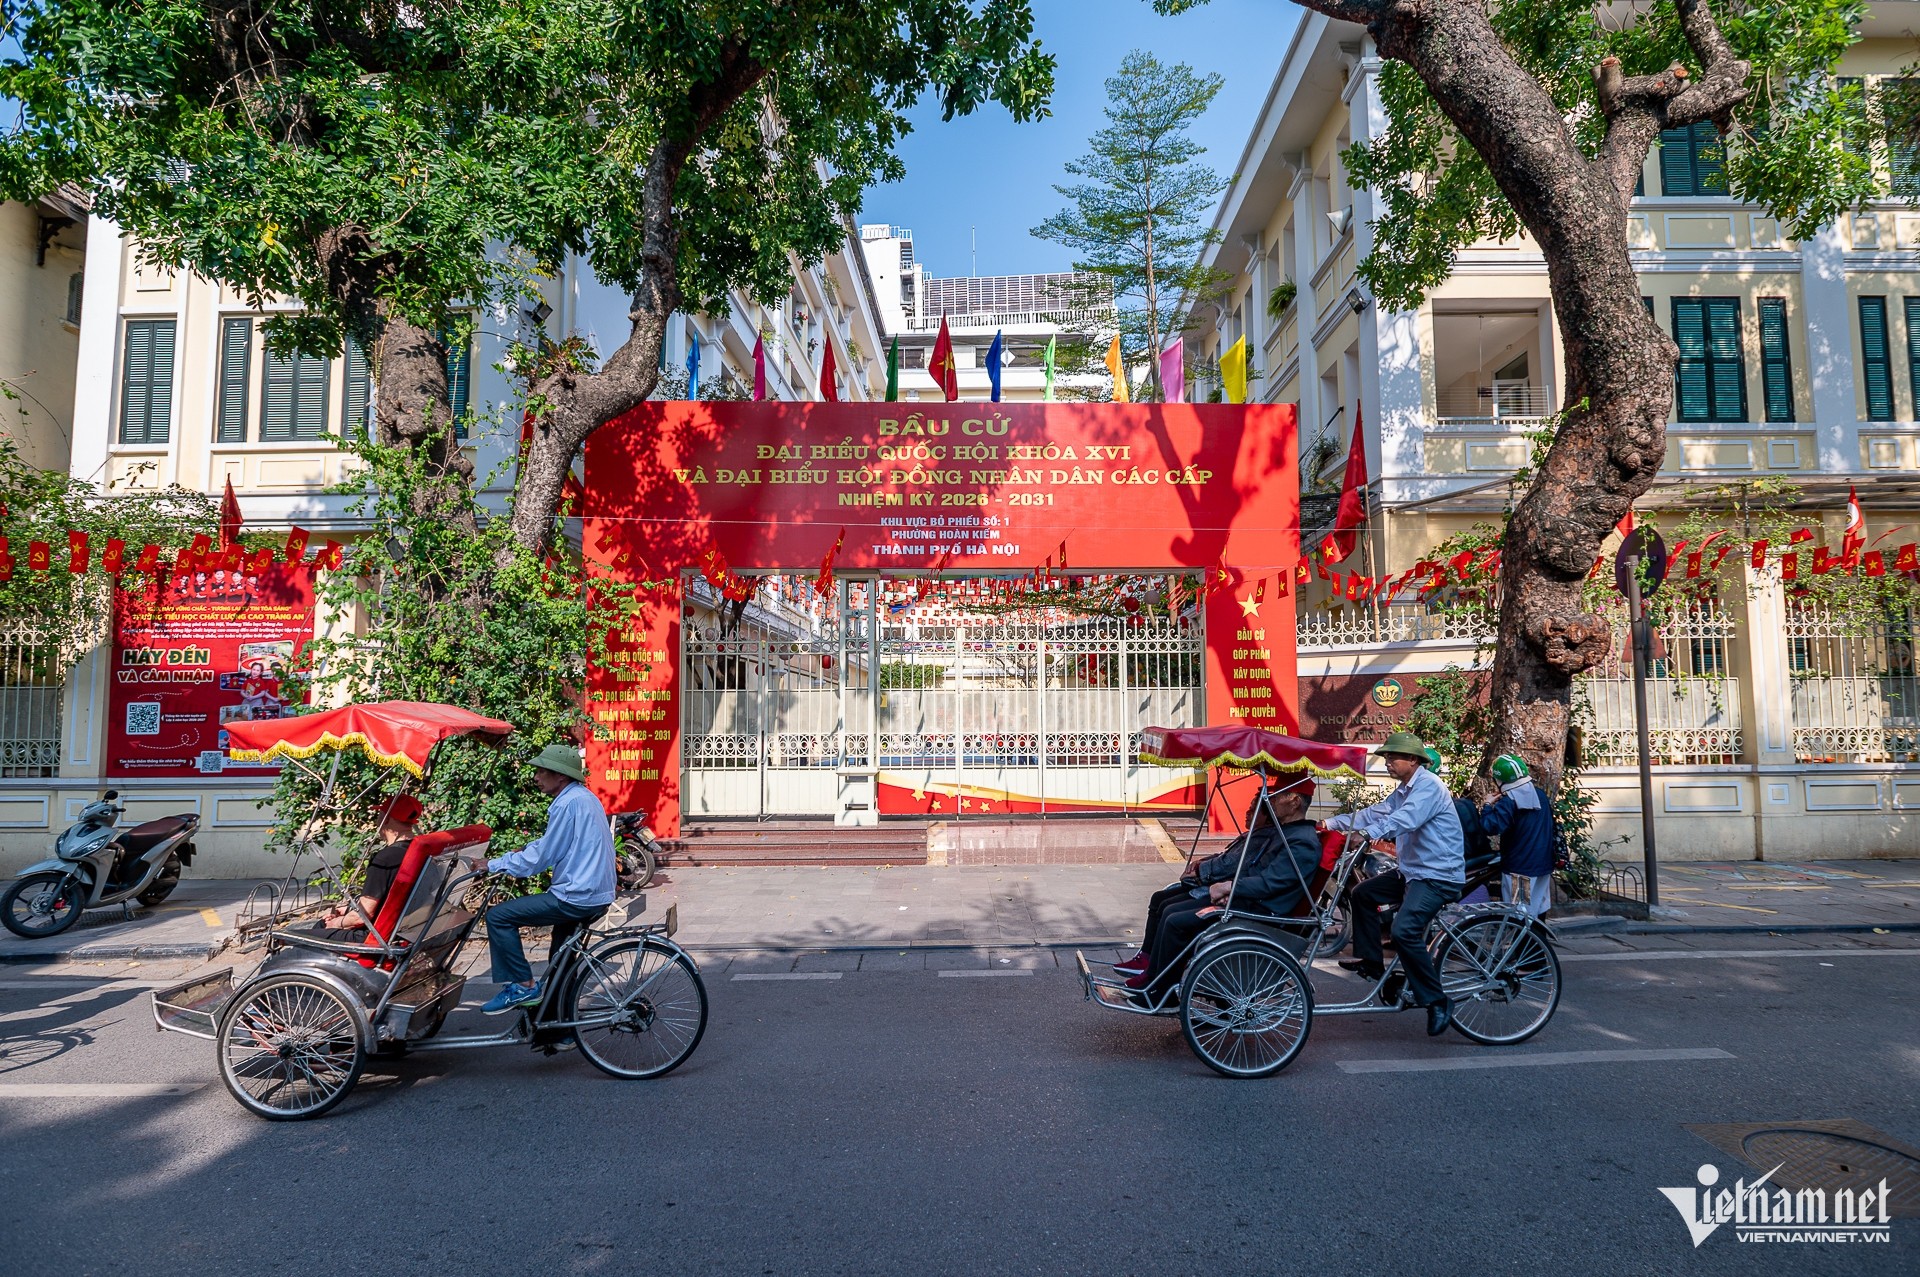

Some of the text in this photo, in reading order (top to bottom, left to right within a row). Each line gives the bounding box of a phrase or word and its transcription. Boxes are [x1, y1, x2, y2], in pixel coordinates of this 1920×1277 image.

[879, 412, 1012, 436] BẦU CỬ
[756, 436, 1130, 463] ĐẠI BIỂU QUỐC HỘI KHÓA XVI
[673, 461, 1213, 488] VÀ ĐẠI BIỂU HỘI ĐỒNG NHÂN DÂN CÁC CẤP
[838, 490, 903, 508] NHIỆM
[909, 490, 935, 506] KỲ
[941, 493, 989, 506] 2026
[1008, 493, 1054, 506] 2031
[880, 514, 1010, 528] KHU VỰC BỎ PHIẾU SỐ: 1
[891, 526, 1000, 539] PHƯỜNG HOÀN KIẾM
[872, 541, 1020, 557] THÀNH PHỐ HÀ NỘI
[181, 613, 199, 621] HỌC
[199, 611, 220, 620] CHẤT
[265, 612, 292, 620] TRÀNG
[620, 629, 647, 643] BẦU CỬ
[1237, 627, 1266, 641] BẦU CỬ
[167, 644, 210, 665] ĐẾN
[632, 648, 652, 662] QUỐC
[653, 649, 666, 664] HỘI
[1233, 645, 1271, 660] GÓP PHẦN
[117, 668, 214, 685] VÀ CẢM NHẬN
[1233, 666, 1271, 682] XÂY DỰNG
[605, 690, 618, 704] ĐẠI
[619, 687, 636, 701] BIỂU
[651, 687, 671, 701] ĐỒNG
[1233, 685, 1272, 699] NHÀ NƯỚC
[598, 706, 667, 721] NHÂN DÂN CÁC CẤP
[1229, 702, 1276, 719] PHÁP QUYỀN
[619, 728, 629, 741] KỲ
[629, 730, 647, 741] 2026
[654, 730, 671, 741] 2031
[1355, 729, 1376, 741] TIN
[610, 749, 653, 762] LÀ NGÀY HỘI
[605, 767, 659, 781] CỦA TOÀN DÂN!
